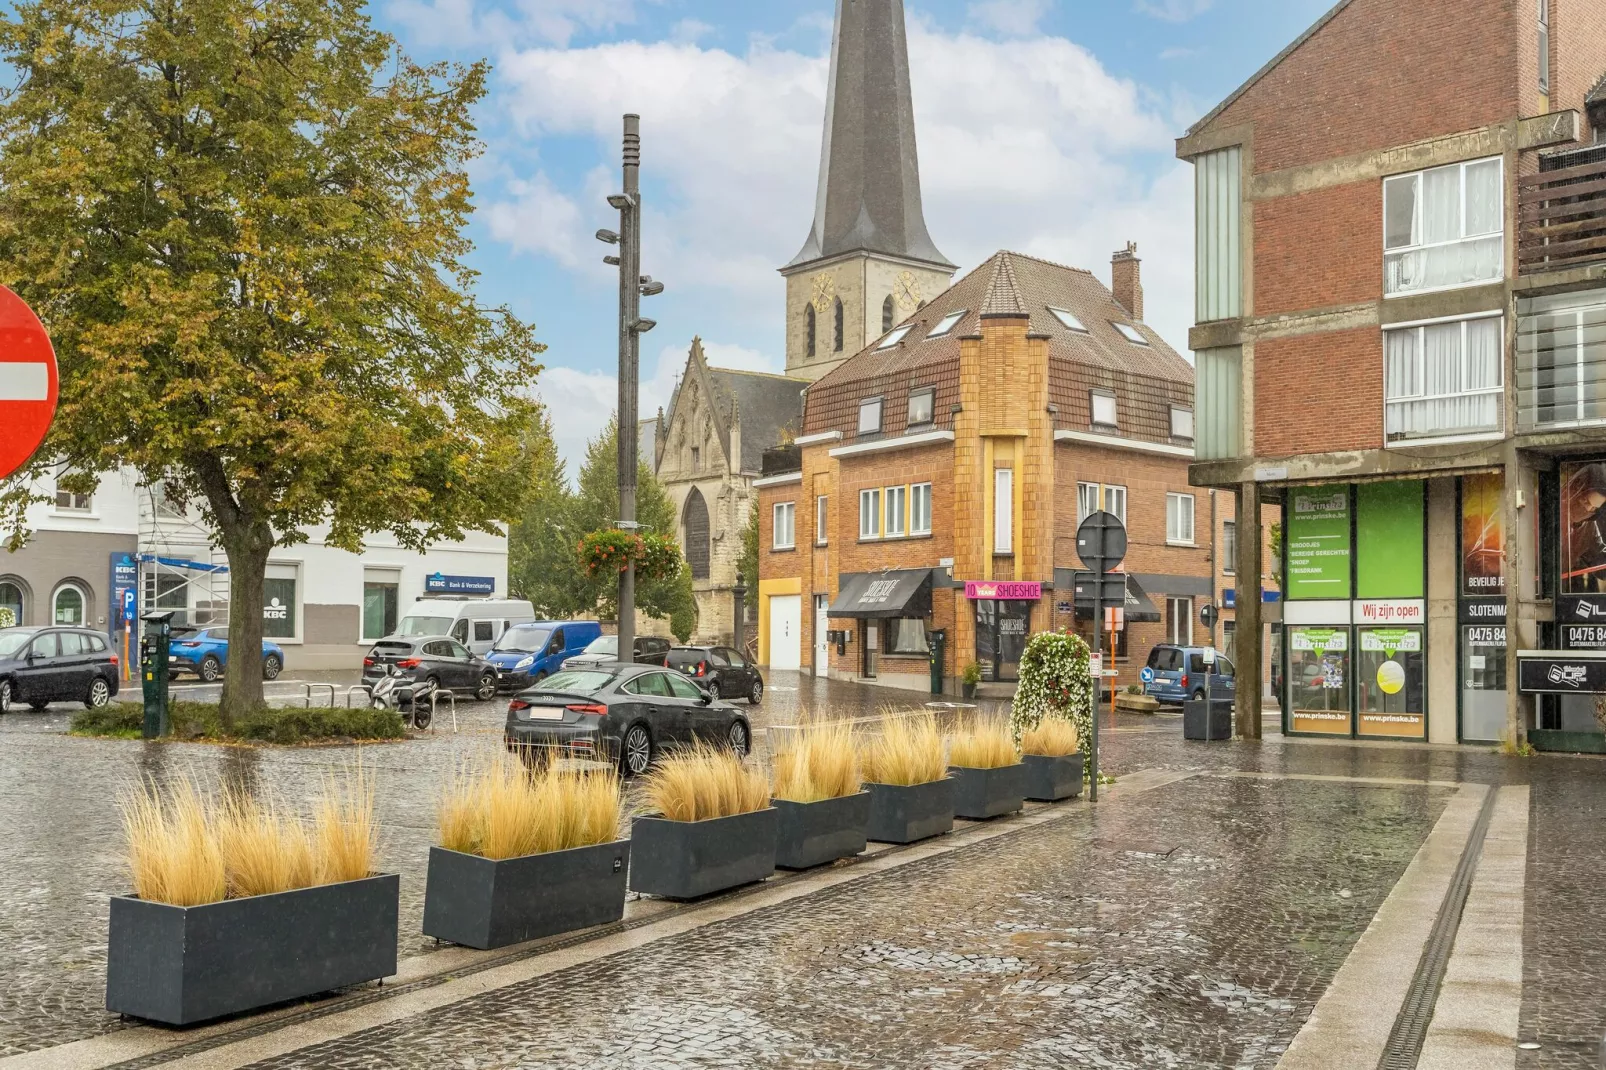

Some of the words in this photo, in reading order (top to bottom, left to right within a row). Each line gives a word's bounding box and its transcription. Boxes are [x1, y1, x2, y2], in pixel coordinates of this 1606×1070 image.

[466, 582, 491, 590] Verzekering
[1468, 577, 1497, 587] BEVEILIG
[1497, 577, 1505, 586] JE
[967, 584, 976, 597] 10
[997, 584, 1040, 597] SHOESHOE
[125, 592, 134, 608] P
[263, 610, 287, 619] KBC
[1362, 604, 1377, 620] Wij
[1378, 604, 1394, 620] zijn
[1396, 606, 1419, 620] open
[1000, 618, 1025, 631] SHOESHOE
[1468, 627, 1492, 641] 0475
[1494, 627, 1506, 641] 84
[1569, 627, 1595, 641] 0475
[1293, 712, 1346, 721] www.prinske.be
[1363, 714, 1419, 723] www.prinske.be
